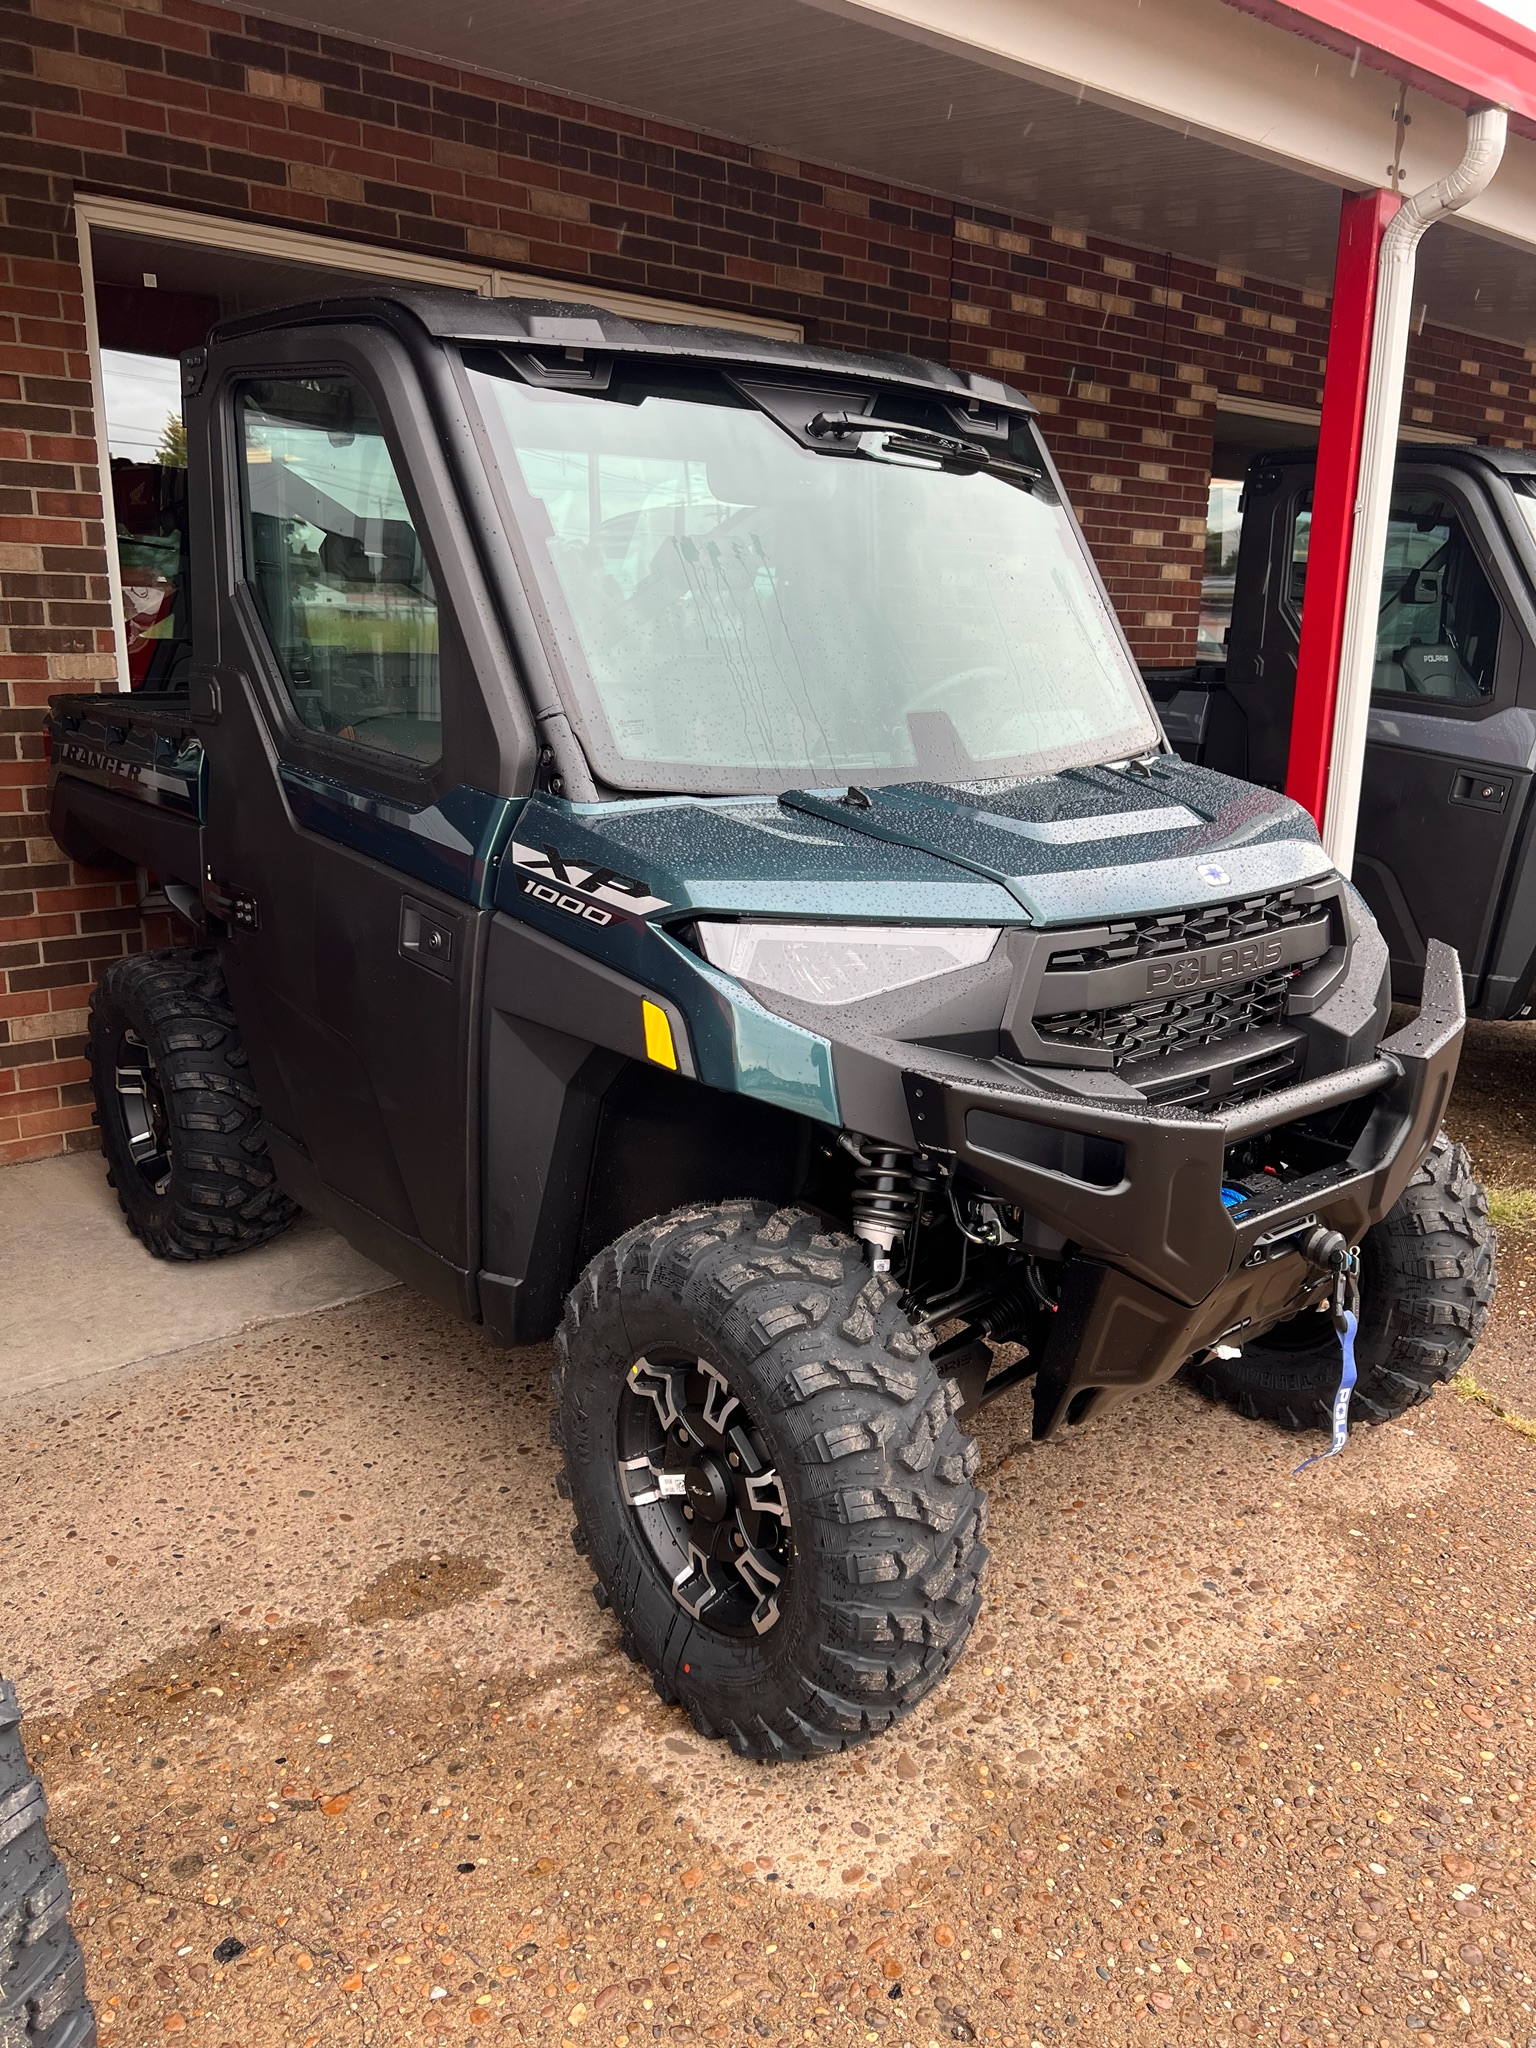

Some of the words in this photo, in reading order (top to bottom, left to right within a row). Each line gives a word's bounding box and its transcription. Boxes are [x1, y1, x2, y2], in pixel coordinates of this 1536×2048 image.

[1424, 655, 1449, 663] POLARIS
[65, 745, 141, 782] RANGER
[517, 843, 653, 898] XP
[523, 880, 613, 926] 1000
[1146, 937, 1282, 994] POLARIS
